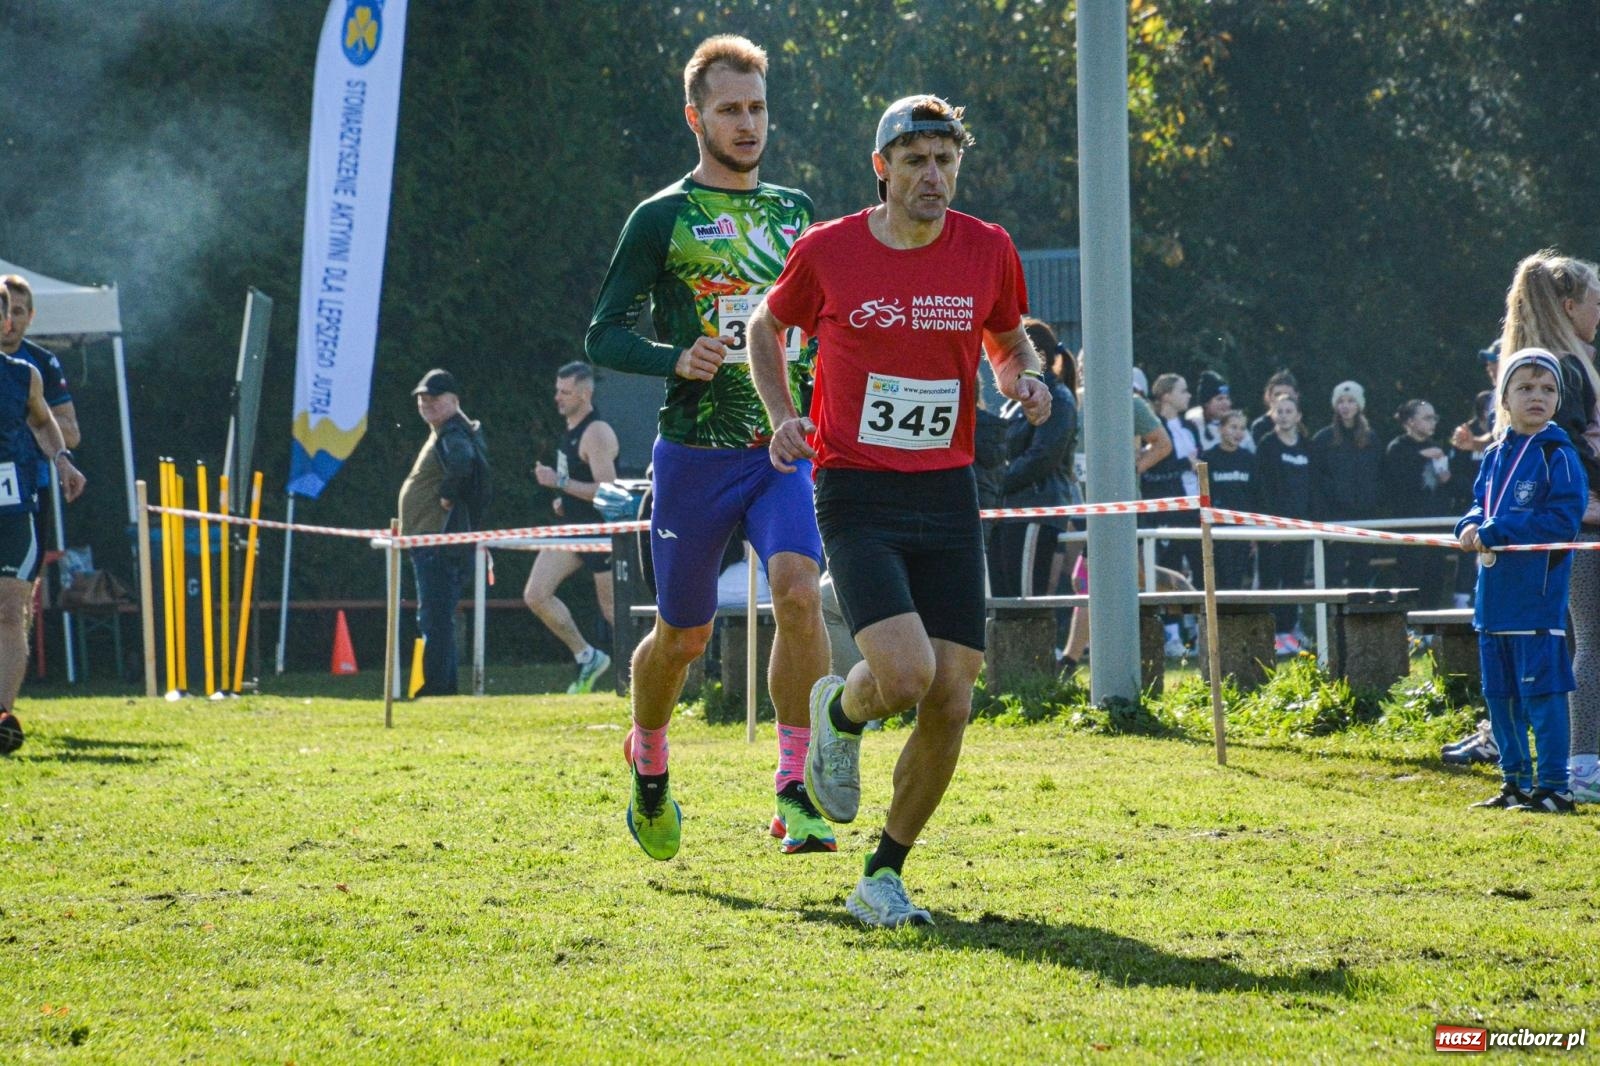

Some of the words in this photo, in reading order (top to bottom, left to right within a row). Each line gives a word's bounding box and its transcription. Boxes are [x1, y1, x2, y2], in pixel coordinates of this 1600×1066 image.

[334, 79, 367, 197] STOWARZYSZENIE
[328, 201, 355, 262] AKTYWNI
[321, 267, 347, 293] DLA
[911, 308, 974, 320] DUATHLON
[912, 295, 974, 308] MARCONI
[315, 299, 344, 368] LEPSZEGO
[911, 317, 973, 331] ŚWIDNICA
[310, 373, 333, 414] JUTRA
[867, 400, 953, 437] 345
